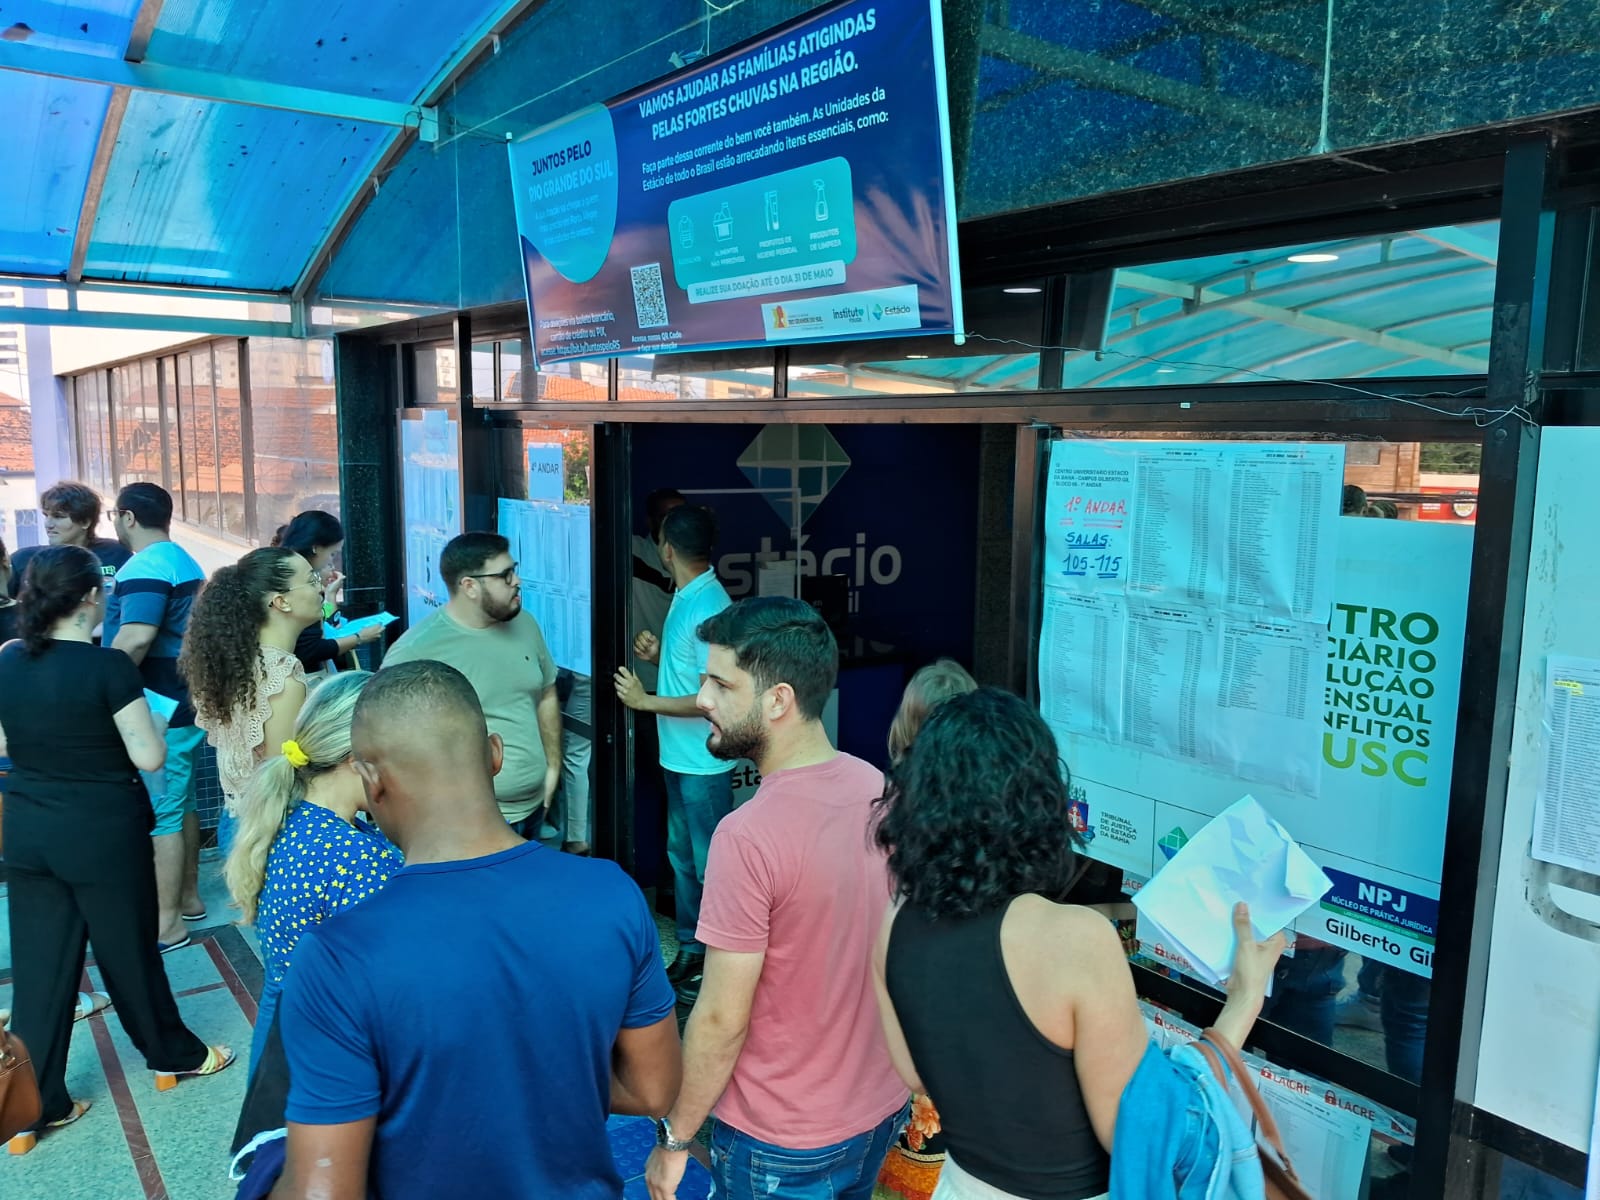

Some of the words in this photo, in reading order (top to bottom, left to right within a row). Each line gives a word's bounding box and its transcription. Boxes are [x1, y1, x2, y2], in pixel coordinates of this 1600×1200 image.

[639, 90, 674, 118] VAMOS
[676, 73, 719, 104] AJUDAR
[721, 65, 736, 88] AS
[738, 40, 796, 80] FAMÍLIAS
[798, 8, 876, 58] ATIGINDAS
[652, 114, 684, 140] PELAS
[685, 98, 727, 129] FORTES
[728, 79, 777, 113] CHUVAS
[779, 72, 799, 96] NA
[801, 49, 858, 88] REGIÃO.
[642, 162, 656, 175] Faça
[657, 156, 674, 172] parte
[675, 152, 694, 164] dessa
[694, 140, 724, 158] corrente
[724, 136, 734, 148] do
[735, 132, 752, 145] bem
[753, 122, 772, 139] você
[772, 112, 811, 133] também.
[812, 106, 824, 120] As
[825, 92, 870, 116] Unidades
[872, 86, 886, 102] da
[532, 150, 566, 176] JUNTOS
[567, 140, 592, 163] PELO
[642, 176, 664, 192] Estácio
[665, 172, 674, 184] de
[674, 168, 690, 181] todo
[696, 159, 714, 176] Brasil
[716, 154, 736, 170] estão
[736, 140, 784, 164] arrecadando
[785, 134, 806, 150] itens
[808, 118, 856, 142] essenciais,
[857, 111, 888, 128] como:
[528, 183, 542, 202] RIO
[543, 171, 579, 198] GRANDE
[580, 166, 593, 186] DO
[594, 160, 614, 181] SUL
[696, 284, 719, 296] REALIZE
[720, 284, 732, 294] SUA
[733, 278, 759, 292] DOAÇÃO
[760, 276, 774, 287] ATÉ
[774, 276, 780, 284] O
[781, 274, 794, 284] DIA
[794, 273, 800, 283] 31
[802, 271, 813, 280] DE
[814, 268, 834, 279] MAIO
[538, 464, 560, 474] ANDAR
[1084, 498, 1128, 516] ANDAR
[1065, 532, 1113, 548] SALAS:
[1322, 732, 1428, 787] USC
[1100, 824, 1110, 832] DO
[1110, 828, 1136, 840] ESTADO
[1101, 811, 1132, 826] TRIBUNAL
[1111, 822, 1137, 834] JUSTIÇA
[1110, 834, 1130, 845] BAHIA
[1358, 882, 1407, 912] NPJ
[1332, 896, 1358, 910] NÚCLEO
[1360, 904, 1369, 914] DE
[1370, 908, 1400, 924] PRÁTICA
[1400, 919, 1432, 934] JURÍDICA
[1326, 918, 1400, 956] Gilberto
[1338, 1098, 1376, 1121] LACRE
